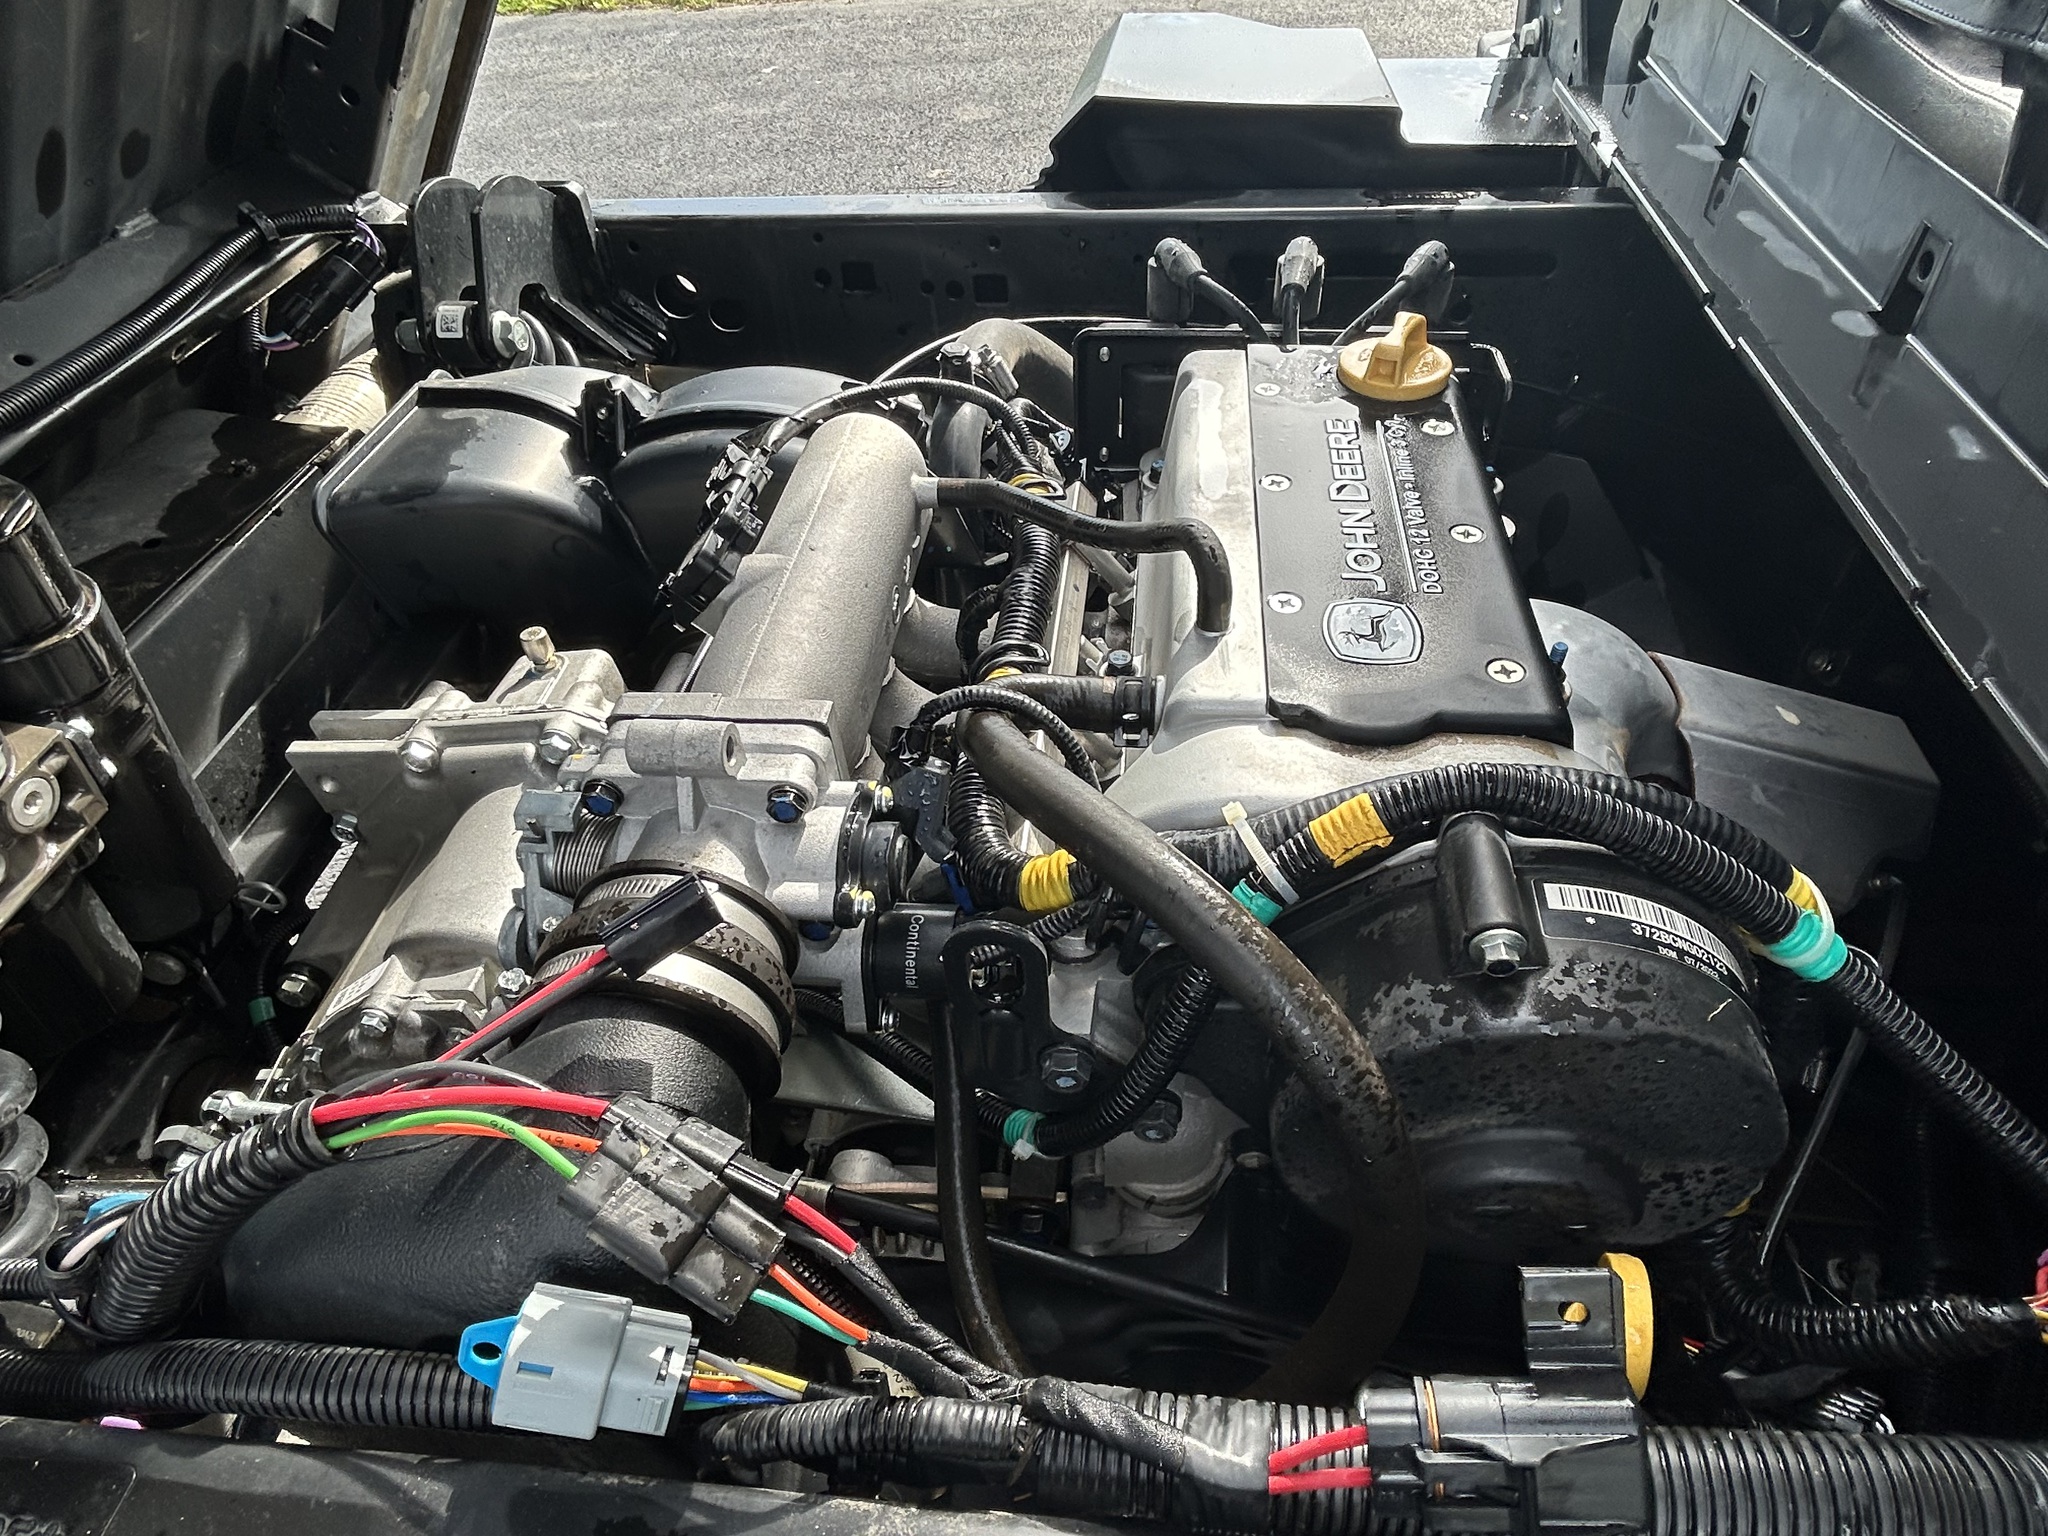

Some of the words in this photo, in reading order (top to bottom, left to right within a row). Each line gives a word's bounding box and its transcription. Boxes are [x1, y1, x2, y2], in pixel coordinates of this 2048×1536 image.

[1325, 418, 1370, 501] DEERE
[1395, 449, 1415, 482] Inline
[1404, 490, 1427, 526] Valve
[1339, 508, 1387, 592] JOHN
[1408, 529, 1431, 545] 12
[1413, 549, 1443, 595] DOHC
[905, 914, 925, 989] Continental
[1657, 945, 1678, 960] DOM
